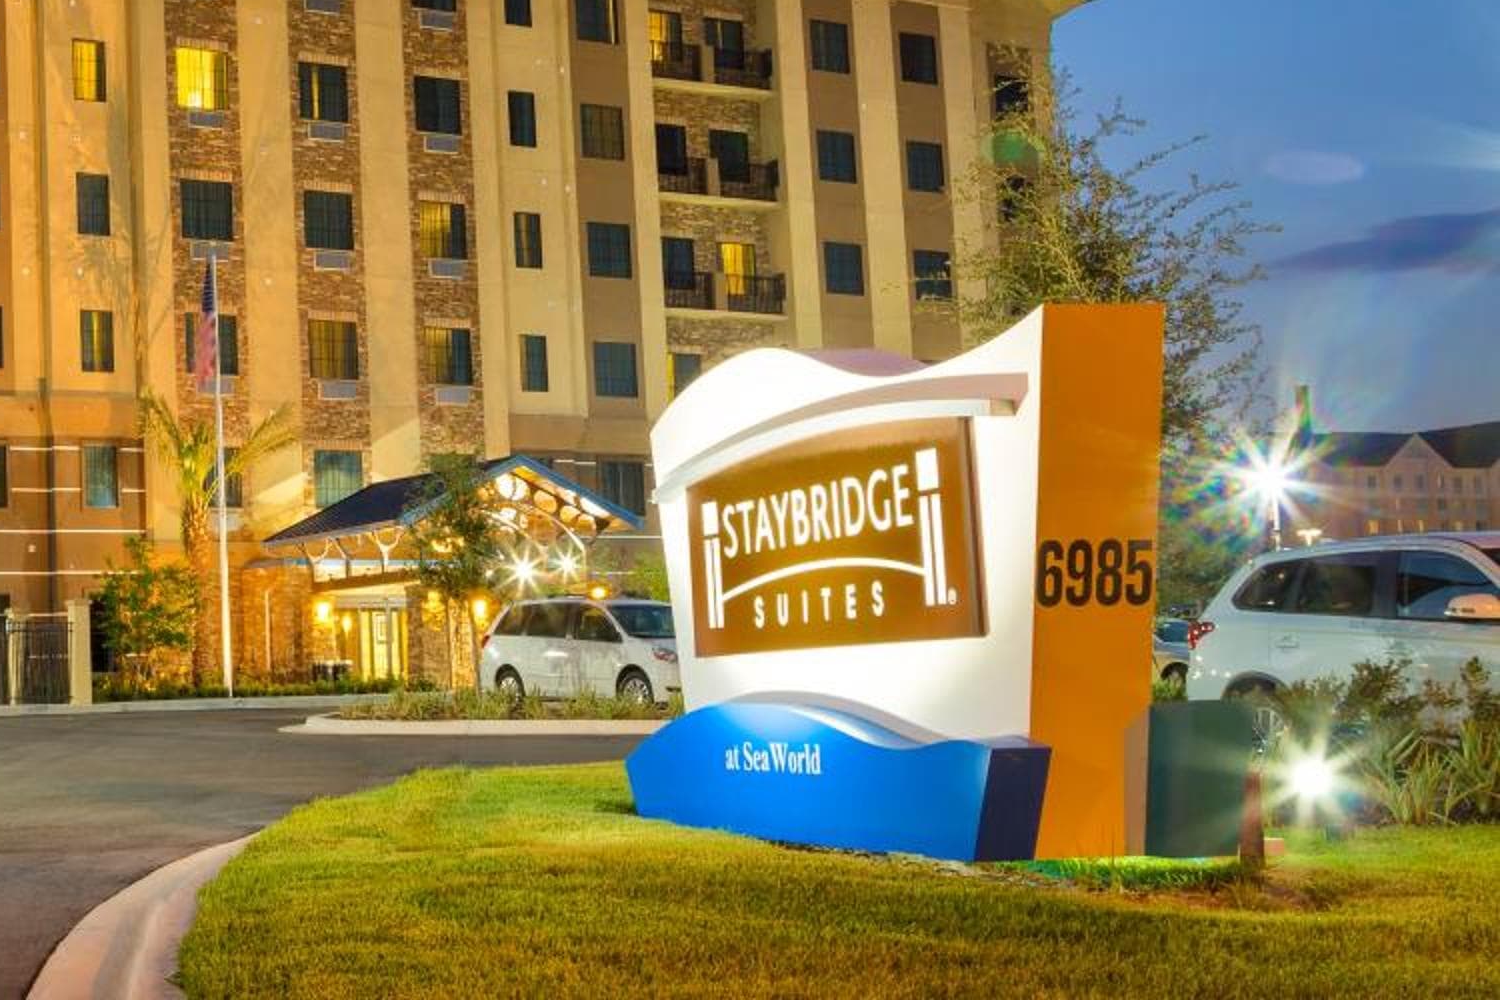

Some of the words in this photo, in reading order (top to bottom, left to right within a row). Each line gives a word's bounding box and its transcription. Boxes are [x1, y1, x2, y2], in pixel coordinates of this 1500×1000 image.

[722, 463, 914, 559] STAYBRIDGE
[1037, 538, 1153, 608] 6985
[753, 579, 885, 629] SUITES
[724, 744, 741, 771] at
